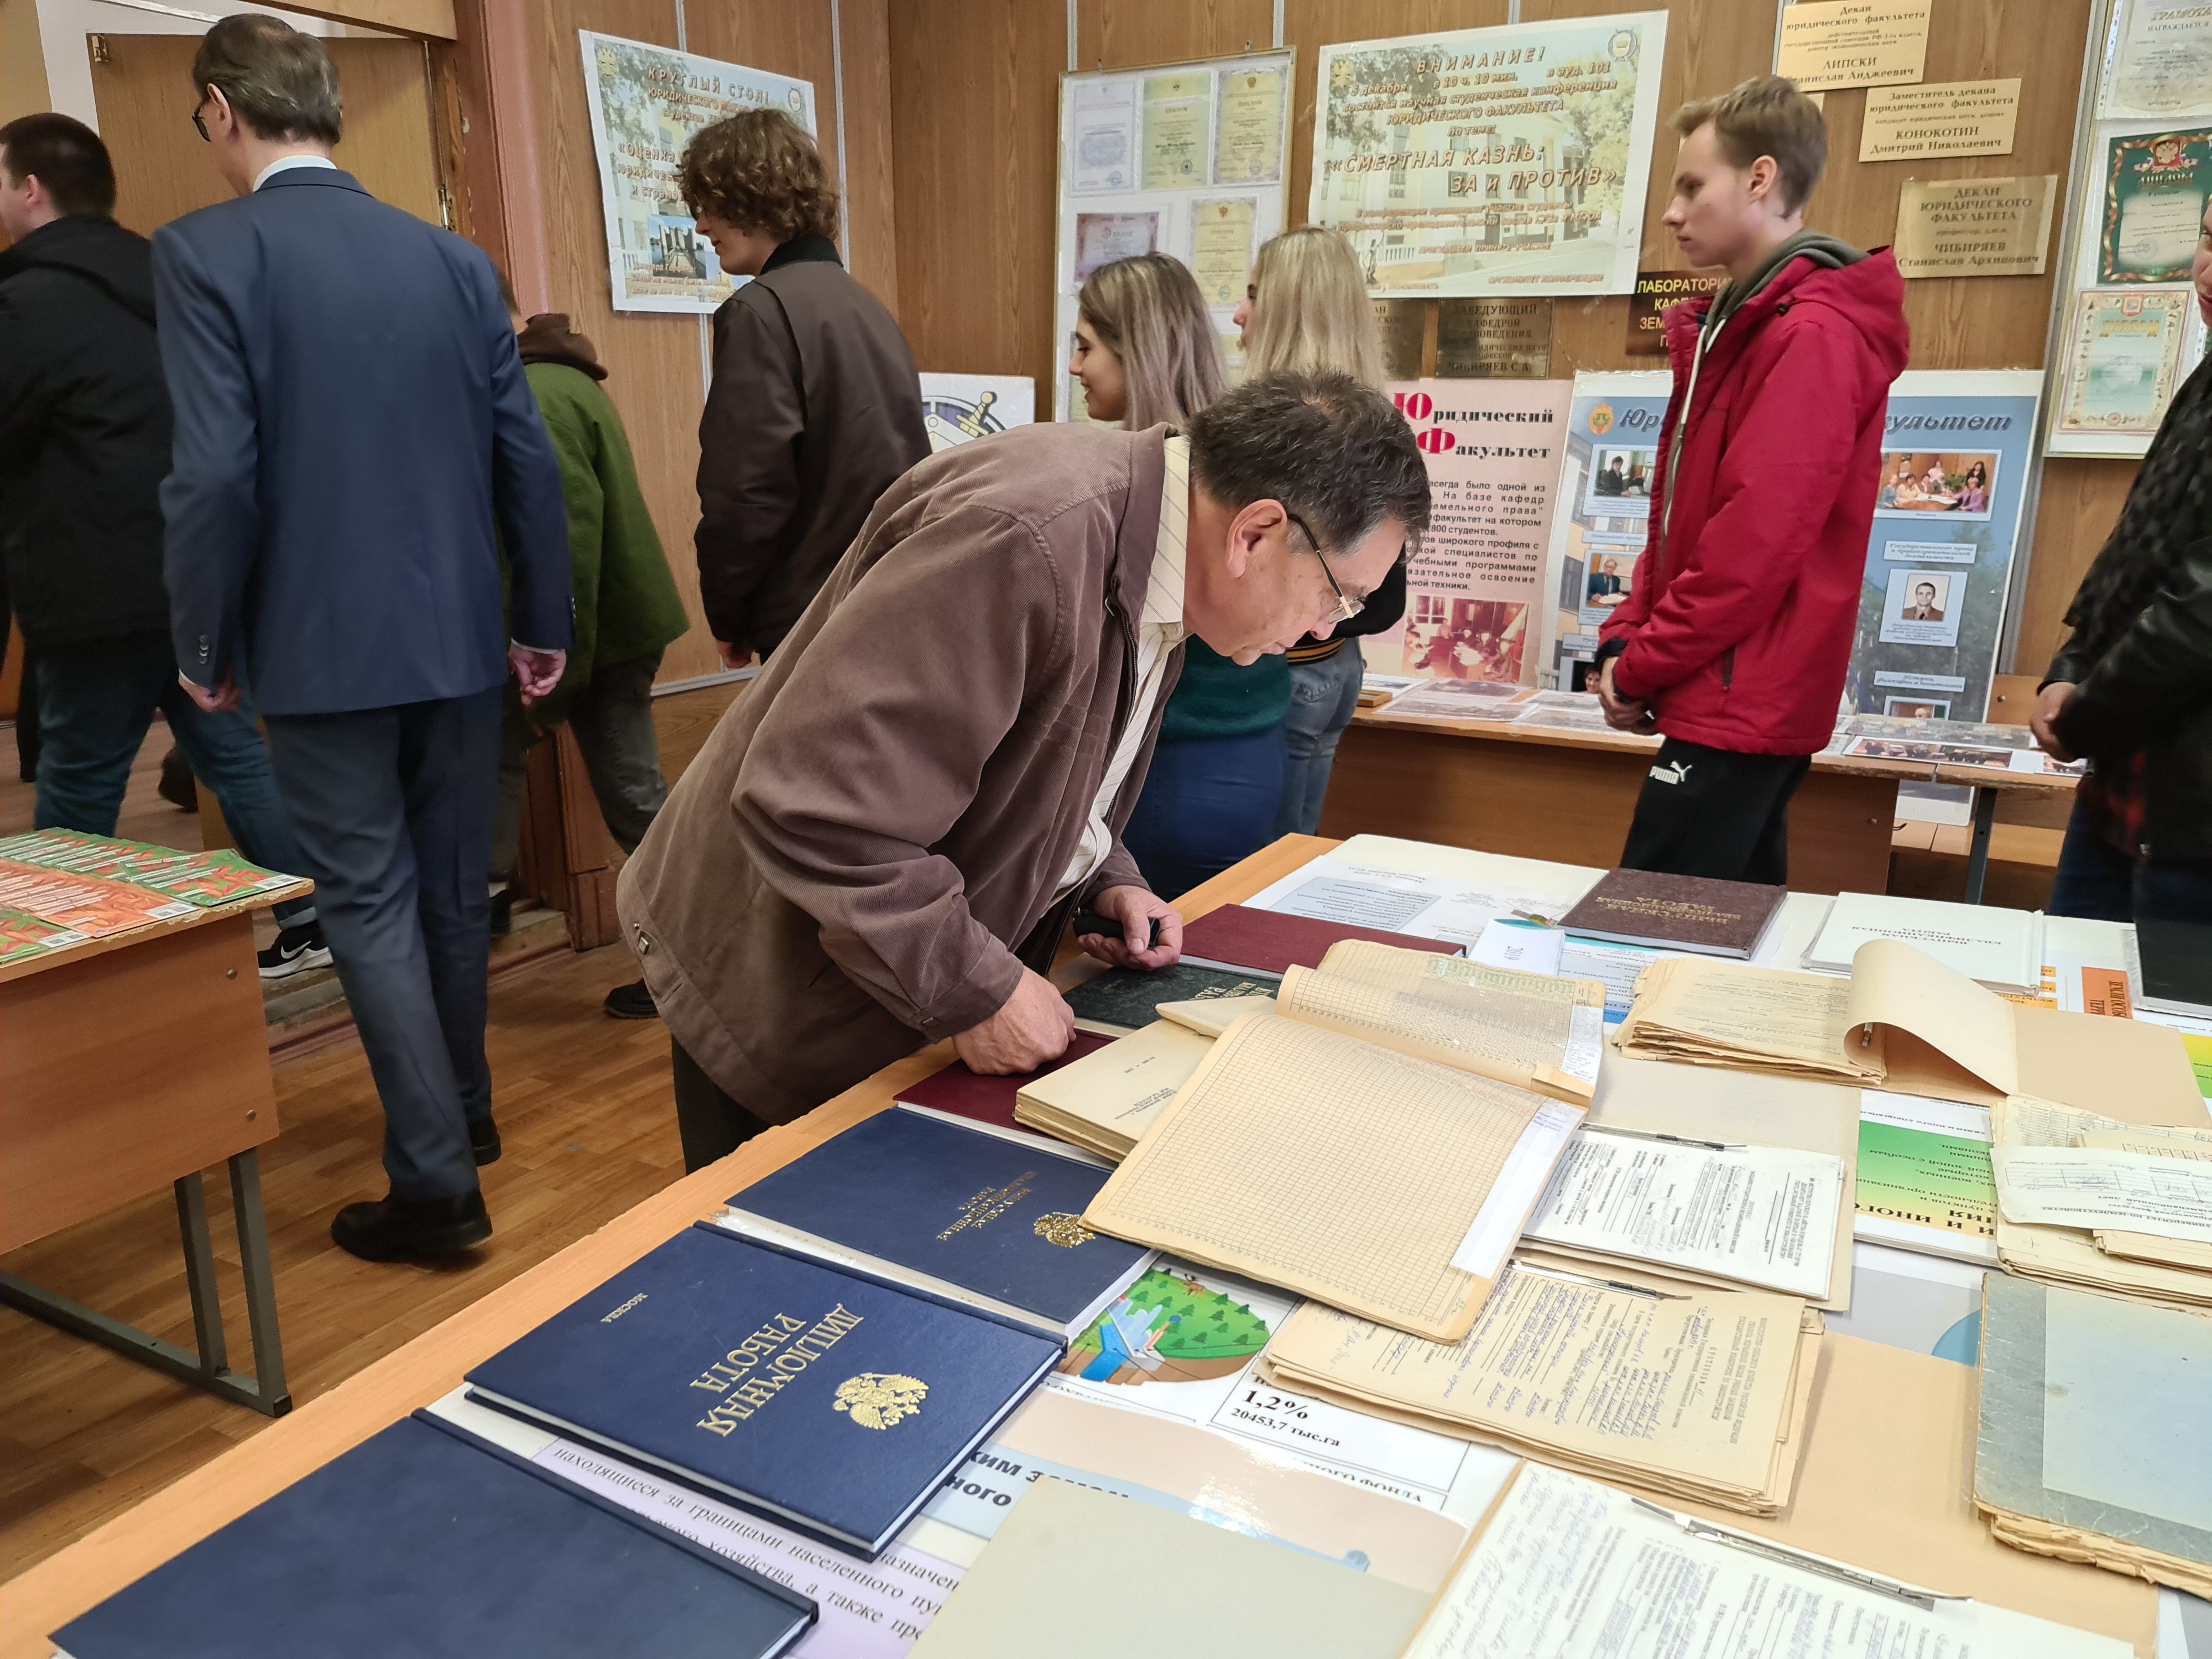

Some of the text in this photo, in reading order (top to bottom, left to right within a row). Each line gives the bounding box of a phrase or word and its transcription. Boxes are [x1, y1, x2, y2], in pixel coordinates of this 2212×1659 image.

[1840, 6, 1871, 17] Декан
[1786, 12, 1925, 31] юридического факультета
[1417, 47, 1545, 74] ВНИМАНИЕ!
[1823, 57, 1877, 70] ЛИПСКИ
[1361, 82, 1407, 96] декабря
[1443, 76, 1458, 88] 10
[1475, 73, 1489, 85] 10
[1491, 72, 1517, 84] мин.
[1557, 66, 1583, 79] ауд.
[1587, 61, 1611, 75] 101
[1785, 68, 1914, 84] танислав Анджеевич
[648, 67, 770, 105] КРУГЛЫЙ СТОЛ!
[1889, 87, 1996, 101] Заместитель декана
[648, 87, 719, 110] ЮРИДИЧЕСКОГО
[1343, 81, 1618, 114] состоится научная студенческая конференция
[1870, 97, 2013, 114] юридического факультета
[1386, 100, 1564, 126] ЮРИДИЧЕСКОГО ФАКУЛЬТЕТА
[1447, 124, 1496, 137] по теме:
[1896, 126, 1979, 140] КОНОКОТИН
[618, 143, 675, 163] «Оценка
[1870, 139, 2001, 155] Дмитрий Николаевич
[1328, 145, 1545, 173] «СМЕРТНАЯ КАЗНЬ:
[617, 163, 676, 182] юридичес
[1449, 166, 1617, 193] ЗА И ПРОТИВ»
[631, 185, 638, 195] и
[1954, 187, 2000, 199] ДЕКАН
[1921, 198, 2032, 212] ЮРИДИЧЕСКОГО
[1931, 210, 2018, 223] ФАКУЛЬТЕТА
[1935, 242, 2006, 253] ЧИБИРЯЕВ
[1899, 255, 2038, 267] Станислав Архипович
[1637, 277, 1732, 294] ЛАБОРАТОРИ
[1467, 319, 1520, 327] КАФЕДРОЙ
[1640, 317, 1665, 330] ЗЕМ
[1393, 393, 1554, 424] Юридический
[1619, 408, 1662, 431] Юр
[1417, 428, 1551, 460] Факультет
[1466, 481, 1490, 489] было
[1498, 483, 1526, 491] одной
[1443, 491, 1545, 505] На базе кафедр
[1431, 503, 1494, 513] емельного
[1433, 513, 1481, 524] факультет
[1500, 518, 1541, 528] котором
[1431, 525, 1498, 536] 800 студентов.
[1438, 538, 1484, 547] широкого
[1488, 541, 1530, 550] профиля
[1444, 548, 1516, 560] специалистов
[1413, 557, 1536, 572] чебными программами
[1408, 569, 1535, 583] язательное освоение
[1431, 581, 1470, 591] техники.
[1505, 945, 1524, 962] 2019
[1947, 1220, 1963, 1229] И
[601, 1292, 648, 1323] МОСКВА
[690, 1312, 807, 1394] РАБОТА
[696, 1302, 864, 1438] ДИПЛОМНАЯ
[1241, 1389, 1309, 1420] 1,2%
[1230, 1408, 1341, 1447] 20453,7 тыс.га
[553, 1448, 661, 1498] находящиеся
[663, 1493, 684, 1509] за
[688, 1503, 784, 1550] границами
[789, 1545, 904, 1600] населенного
[879, 1552, 960, 1593] азначен
[805, 1582, 819, 1594] а
[827, 1590, 884, 1623] также
